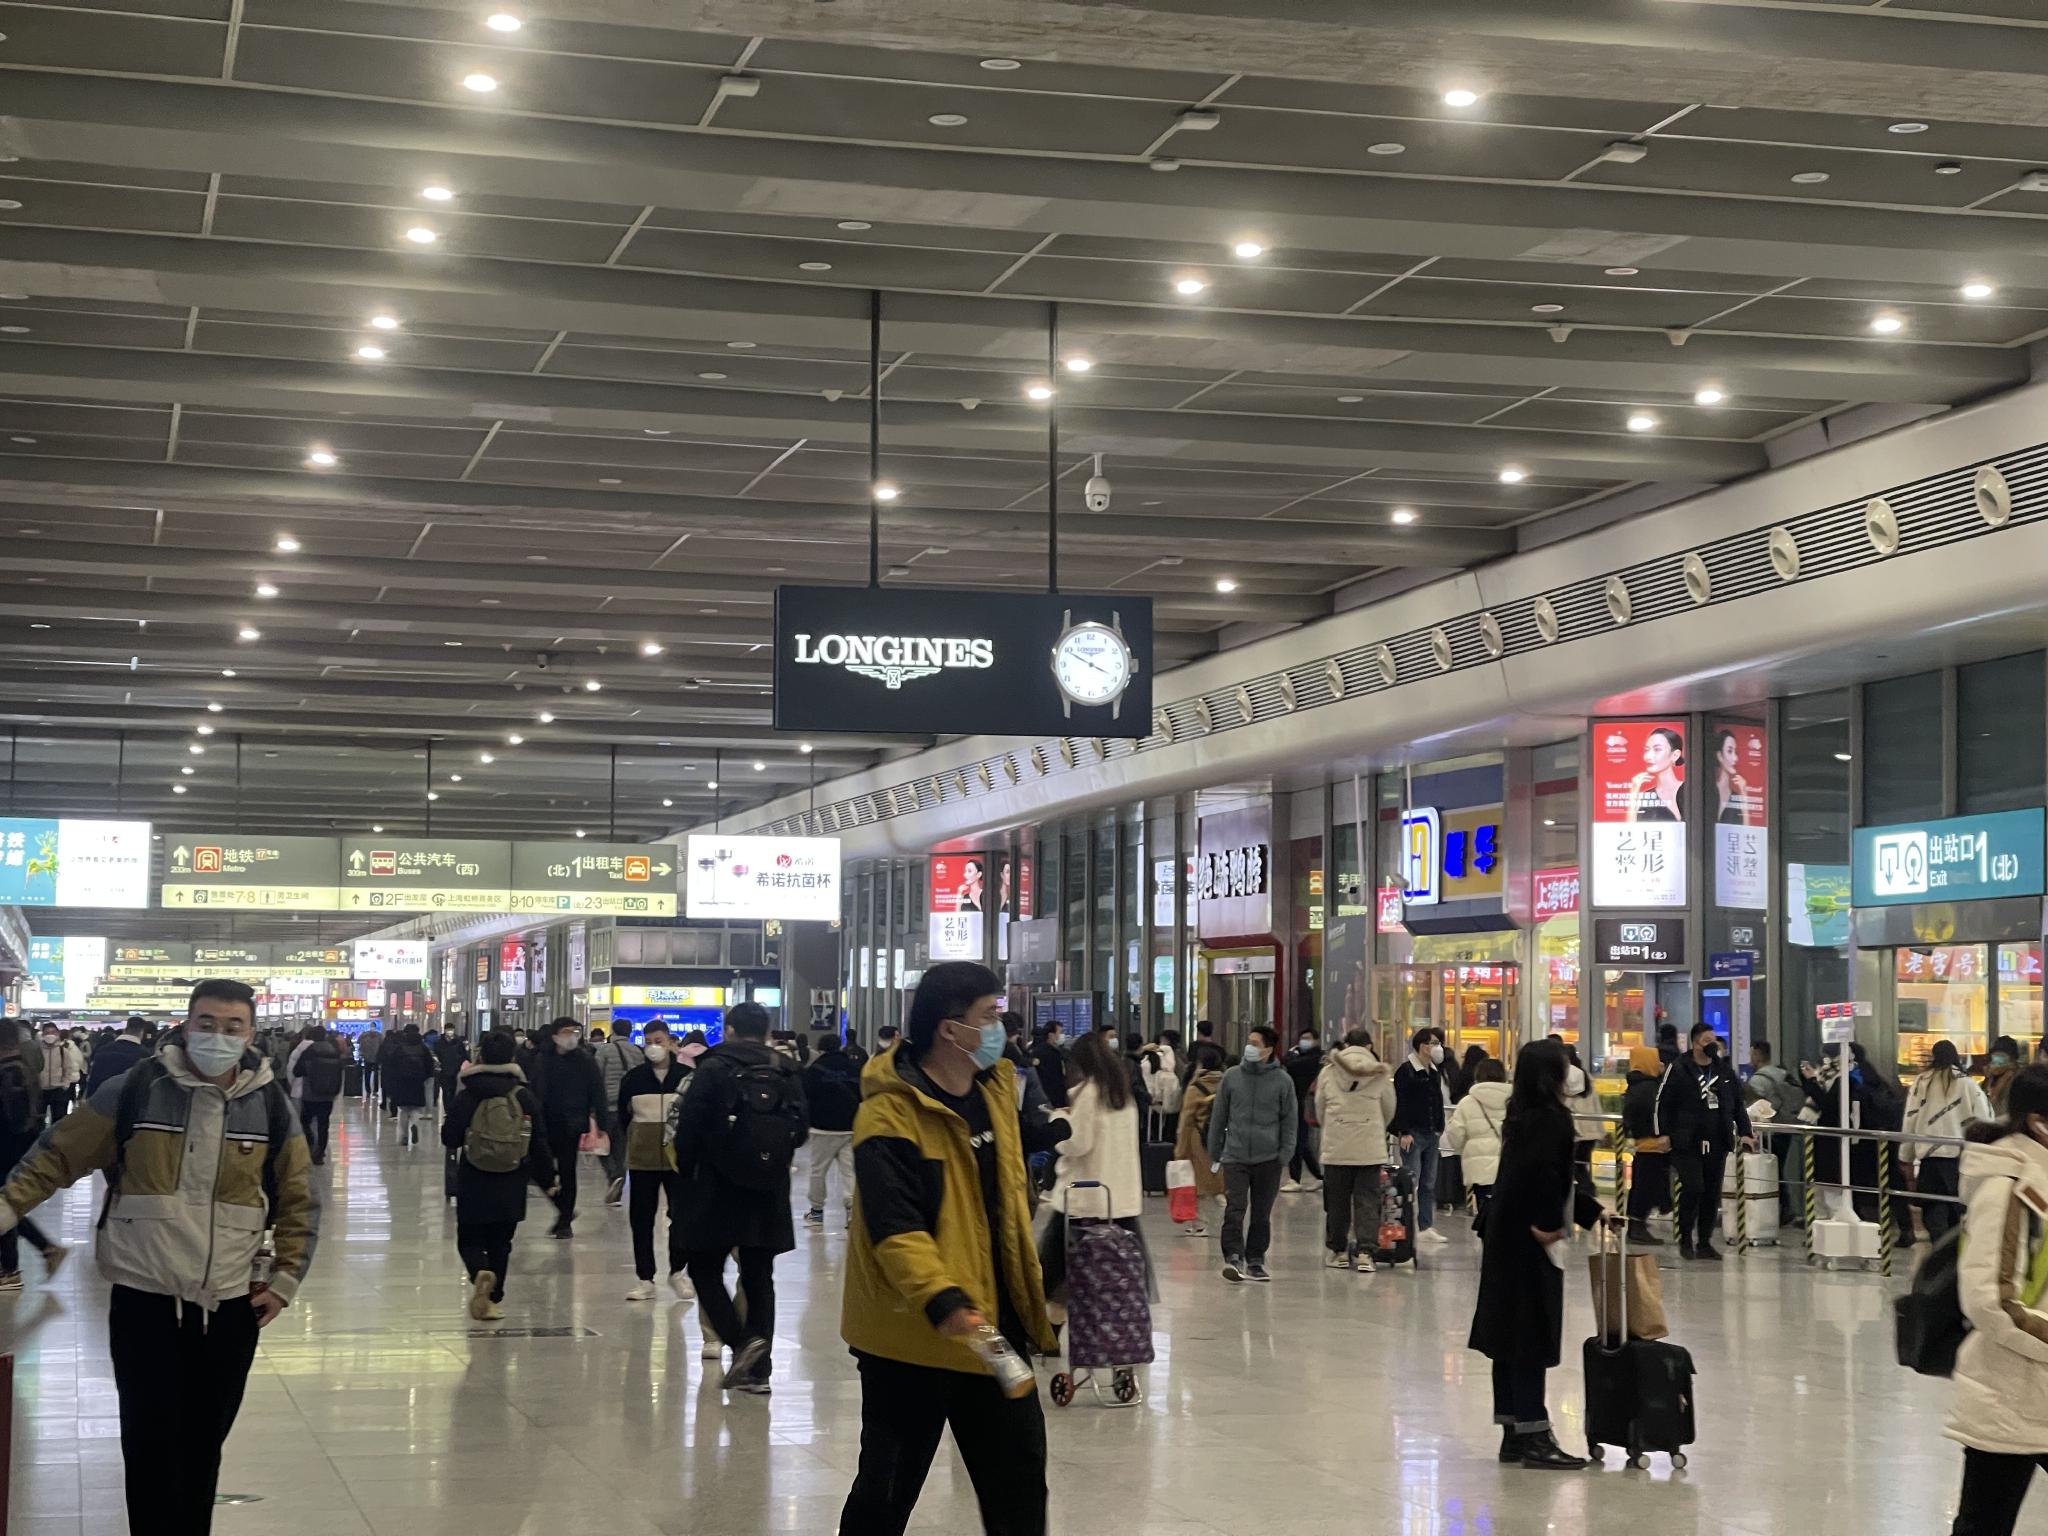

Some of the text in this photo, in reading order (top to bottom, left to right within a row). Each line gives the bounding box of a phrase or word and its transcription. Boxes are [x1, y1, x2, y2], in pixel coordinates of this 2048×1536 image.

[794, 633, 995, 669] LONGINES
[223, 848, 255, 864] 地铁
[398, 852, 480, 876] 公共汽车 (西)
[1929, 830, 2019, 884] 出站口 1 (北)
[222, 864, 246, 873] Metro
[397, 867, 422, 875] Buses
[547, 856, 624, 878] (北) 1 出租车
[608, 871, 623, 879] Taxi
[756, 871, 832, 889] 希诺抗菌杯
[1929, 870, 1948, 887] Exit
[385, 893, 404, 906] 2F
[297, 950, 306, 962] 2
[1610, 945, 1641, 957] 出站口
[1640, 945, 1650, 960] 1
